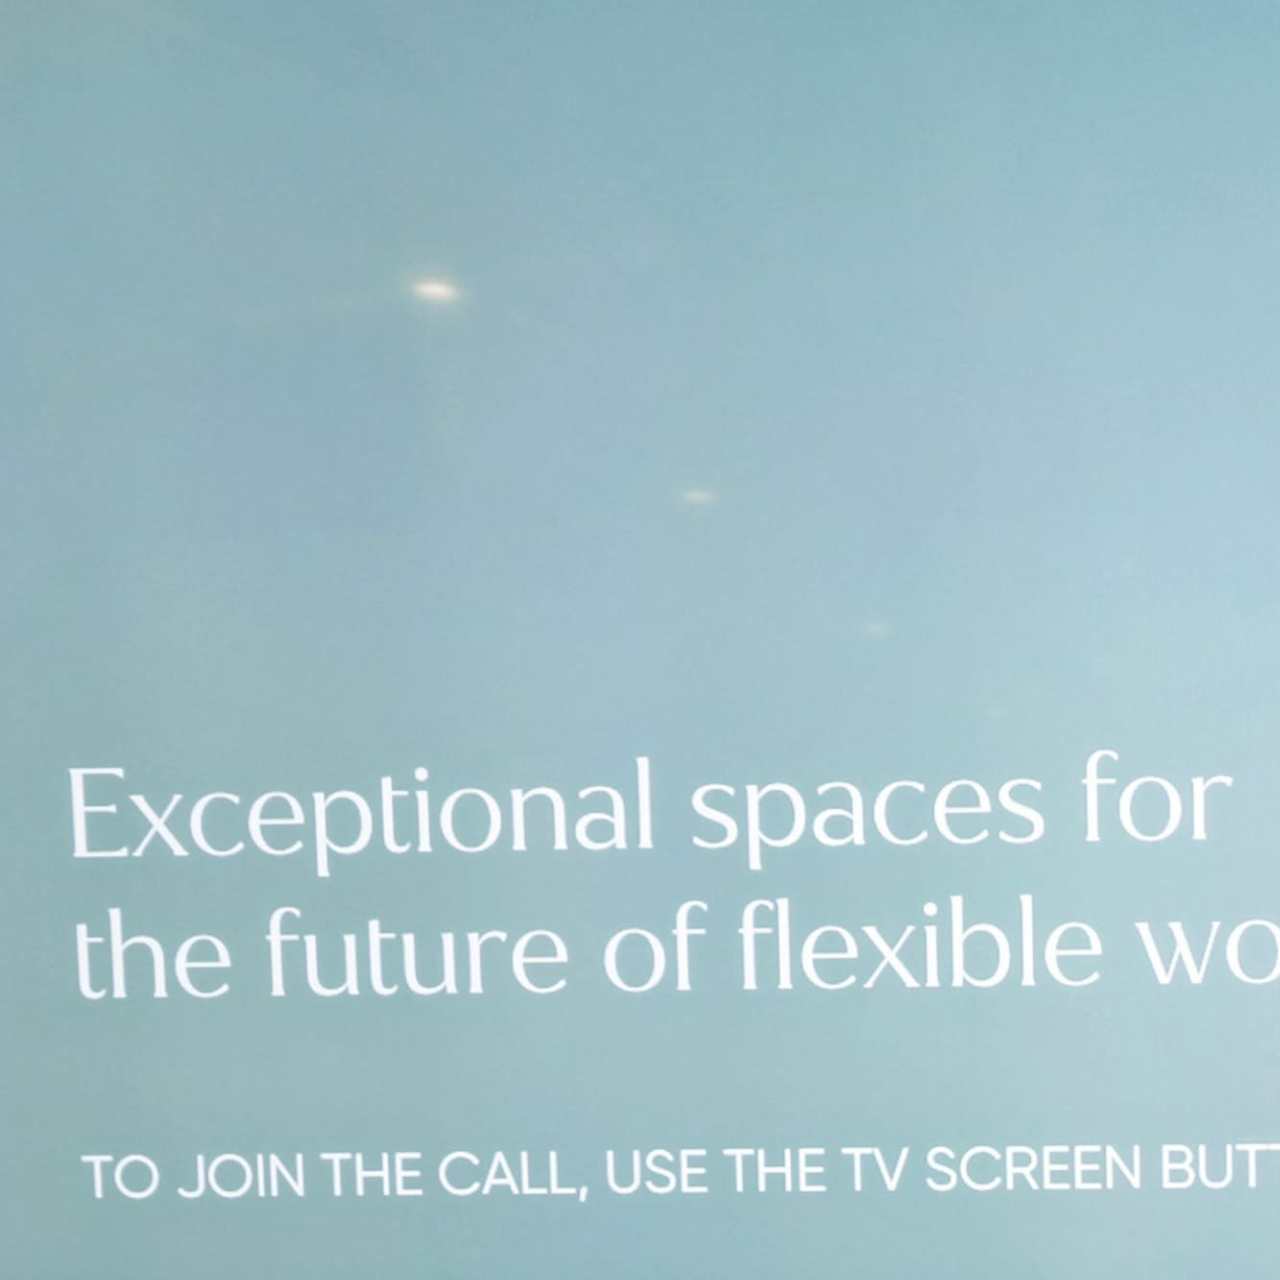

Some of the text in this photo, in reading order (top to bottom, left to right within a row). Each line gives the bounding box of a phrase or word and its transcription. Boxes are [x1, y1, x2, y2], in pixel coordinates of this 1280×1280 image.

[69, 748, 1234, 878] Exceptional spaces for
[76, 907, 232, 1000] the
[266, 906, 569, 997] future
[603, 899, 709, 994] of
[737, 893, 1104, 991] flexible
[80, 1153, 160, 1200] TO
[177, 1152, 305, 1199] JOIN
[319, 1150, 424, 1197] THE
[437, 1150, 589, 1203] CALL,
[605, 1147, 709, 1196] USE
[721, 1146, 828, 1193] THE
[840, 1146, 910, 1193] TV
[925, 1143, 1142, 1193] SCREEN
